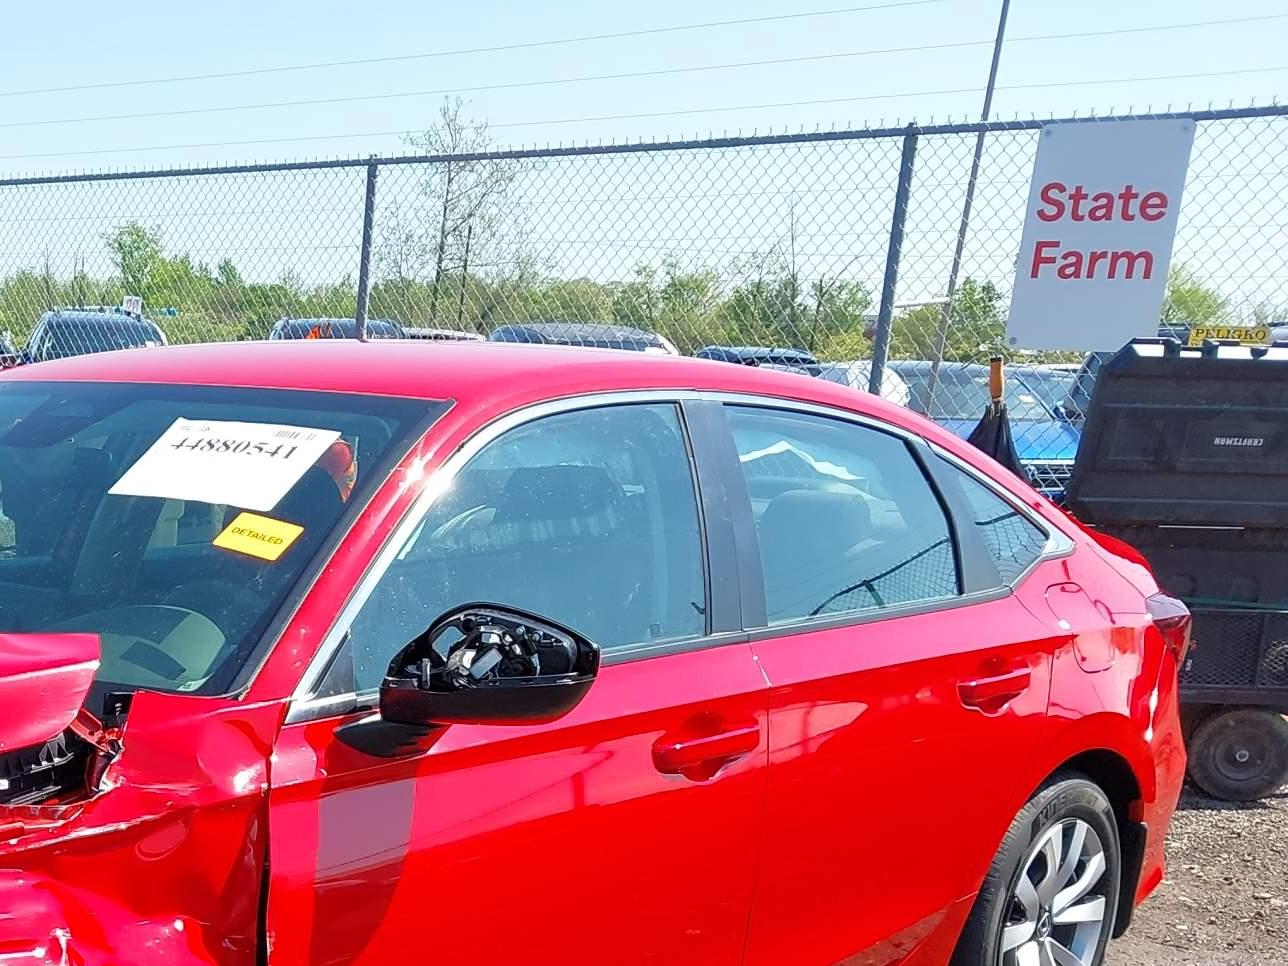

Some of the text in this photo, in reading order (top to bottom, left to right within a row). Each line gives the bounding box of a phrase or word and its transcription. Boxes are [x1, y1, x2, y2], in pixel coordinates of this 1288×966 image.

[1036, 182, 1169, 222] State
[1030, 240, 1154, 280] Farm
[170, 437, 299, 460] 44880541
[1214, 437, 1264, 446] CRAFTSMAN
